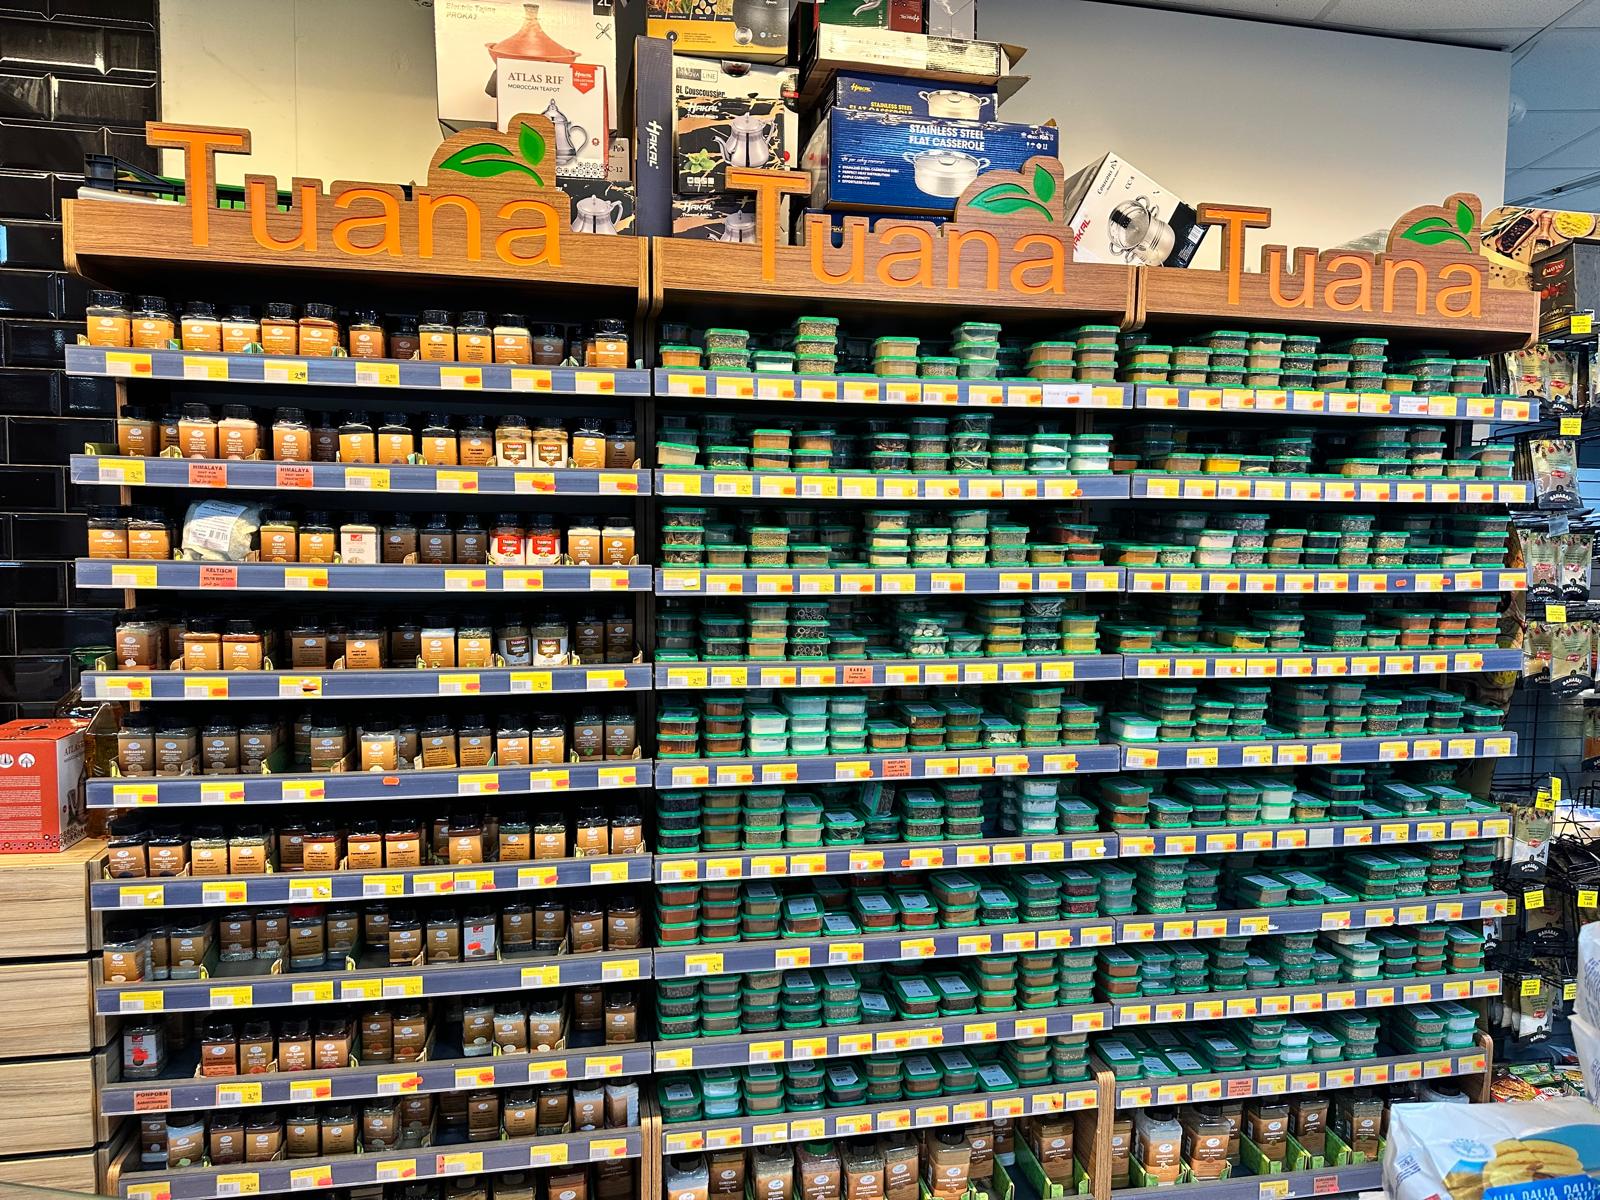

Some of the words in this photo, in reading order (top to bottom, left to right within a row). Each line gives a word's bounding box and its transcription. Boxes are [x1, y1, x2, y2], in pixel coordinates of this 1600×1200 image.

[507, 72, 543, 84] ATLAS
[545, 74, 564, 85] RIF
[702, 72, 716, 80] LINE
[507, 84, 539, 92] MOROCCAN
[908, 123, 958, 138] STAINLESS
[959, 128, 985, 140] STEEL
[908, 136, 931, 146] FLAT
[932, 137, 985, 151] CASSEROLE
[152, 127, 563, 267] Tuana
[732, 173, 1066, 295] Tuana
[1205, 208, 1483, 319] Tuana
